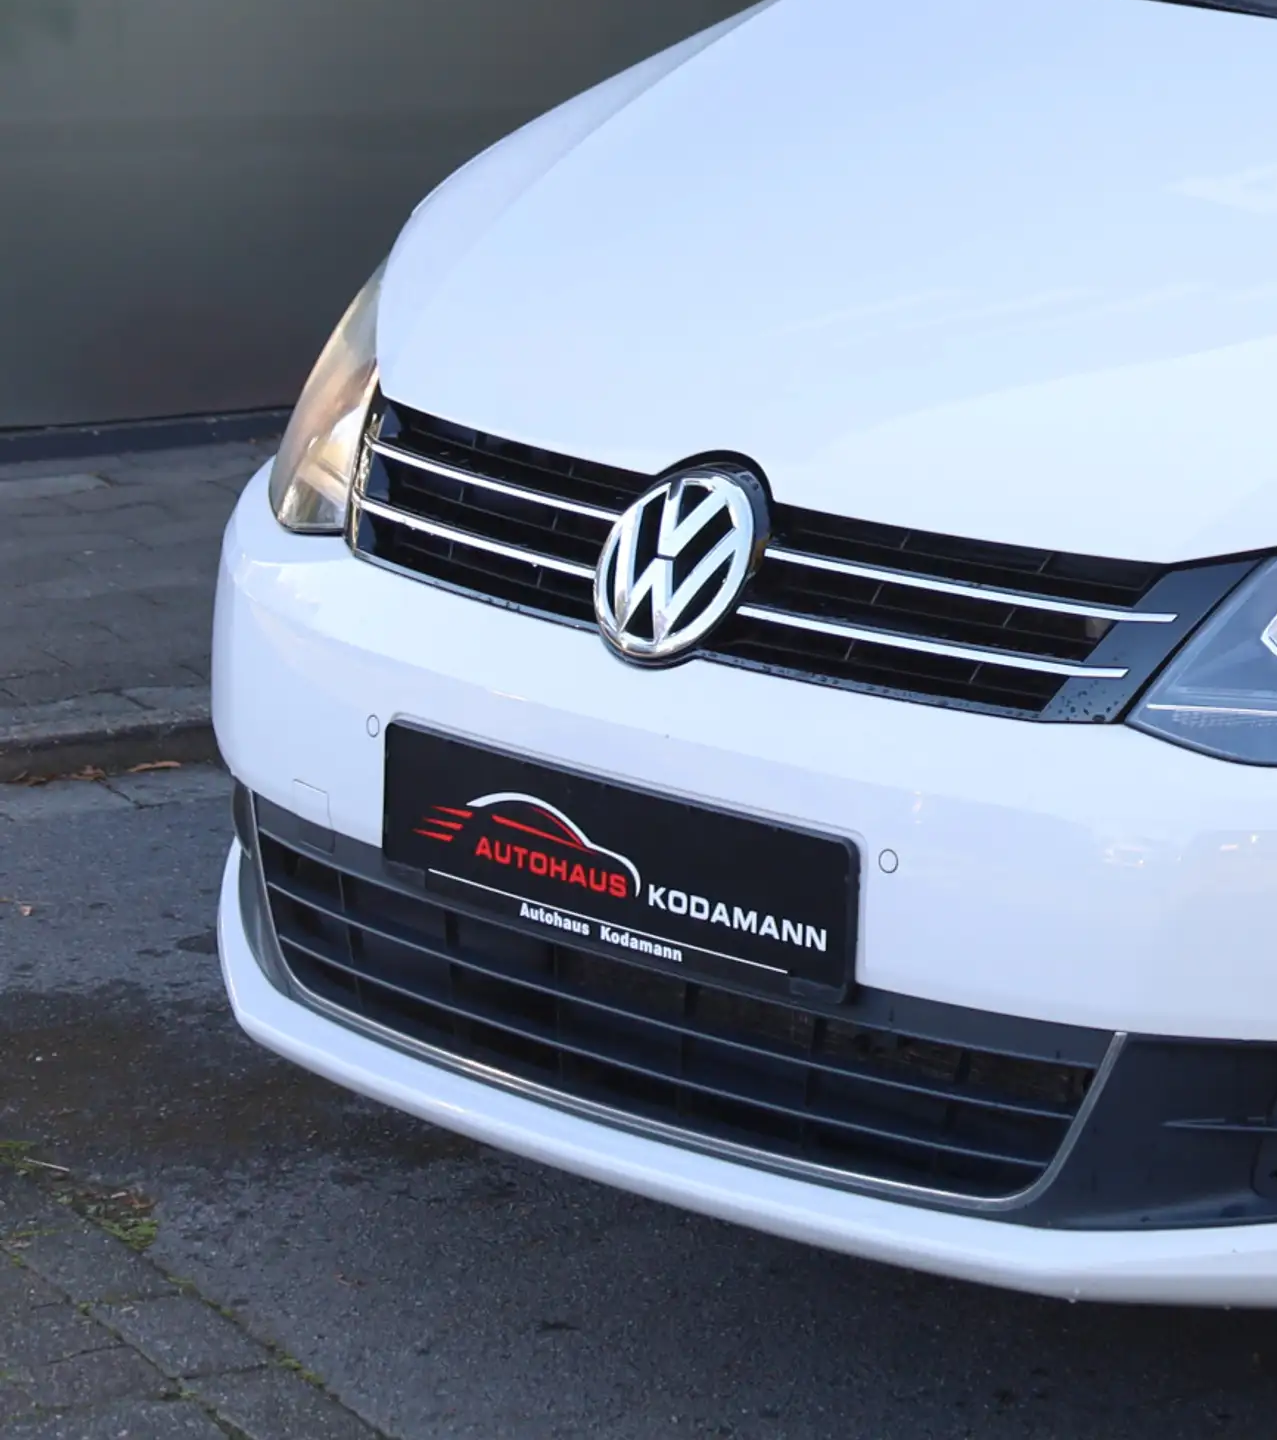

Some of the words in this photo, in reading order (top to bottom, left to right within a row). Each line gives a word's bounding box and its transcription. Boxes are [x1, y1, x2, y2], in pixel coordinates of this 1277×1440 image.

[475, 836, 628, 899] AUTOHAUS
[648, 883, 828, 952] KODAMANN
[519, 902, 590, 936] Autohaus
[600, 925, 683, 962] Kodamann
